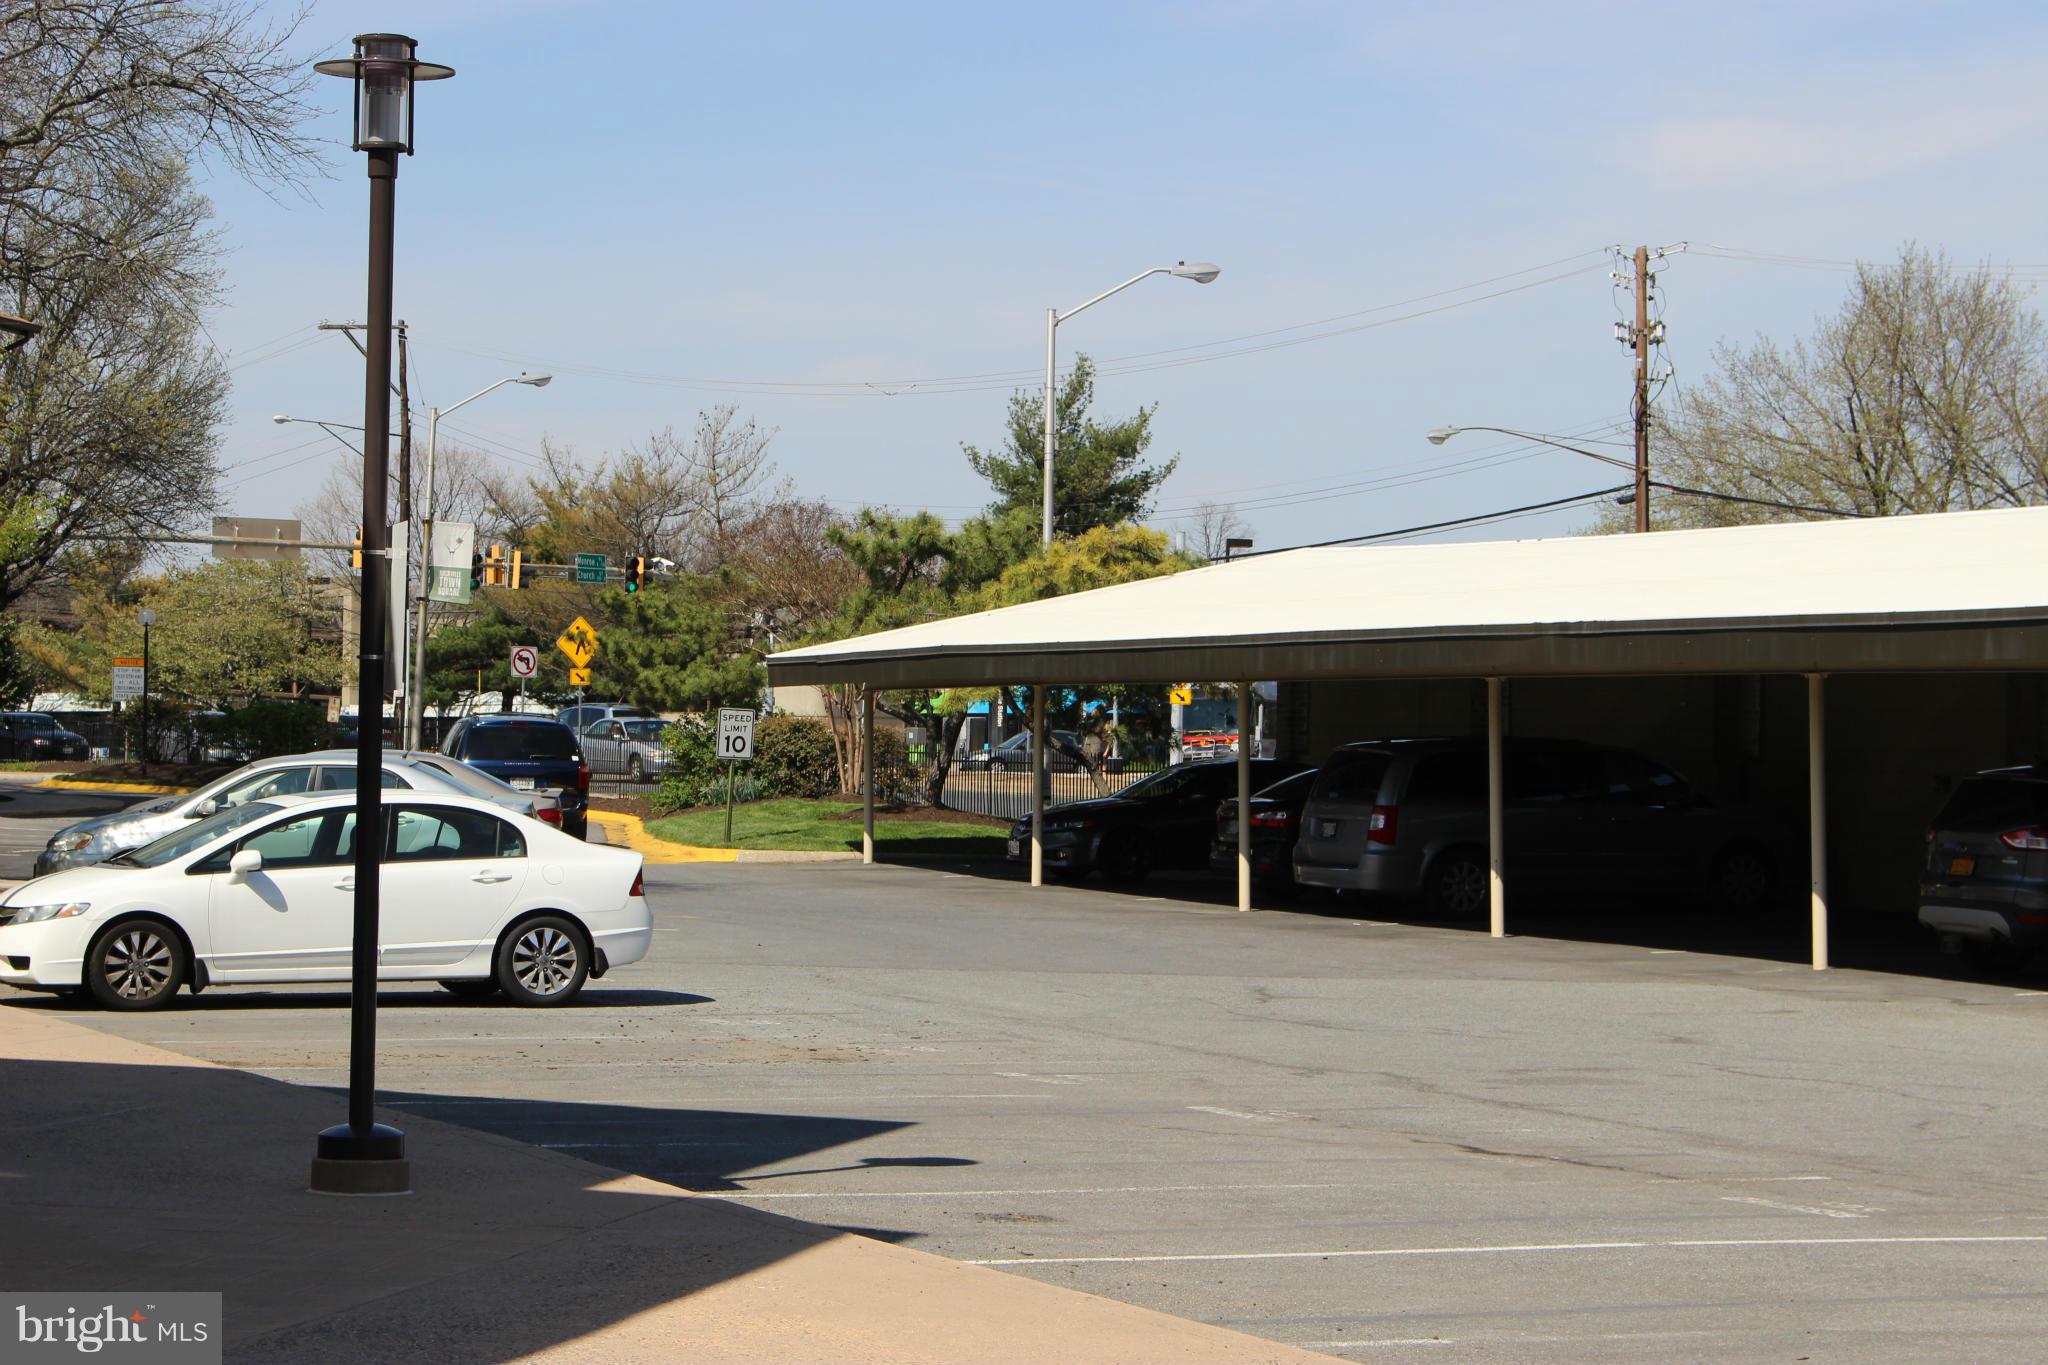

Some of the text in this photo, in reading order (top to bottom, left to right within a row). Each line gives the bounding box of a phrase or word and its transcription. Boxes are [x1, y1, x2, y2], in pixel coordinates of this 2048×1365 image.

[577, 556, 596, 566] Monroe
[578, 570, 596, 580] Church
[439, 576, 461, 588] TOWN
[722, 714, 752, 723] SPEED
[725, 735, 746, 753] 10
